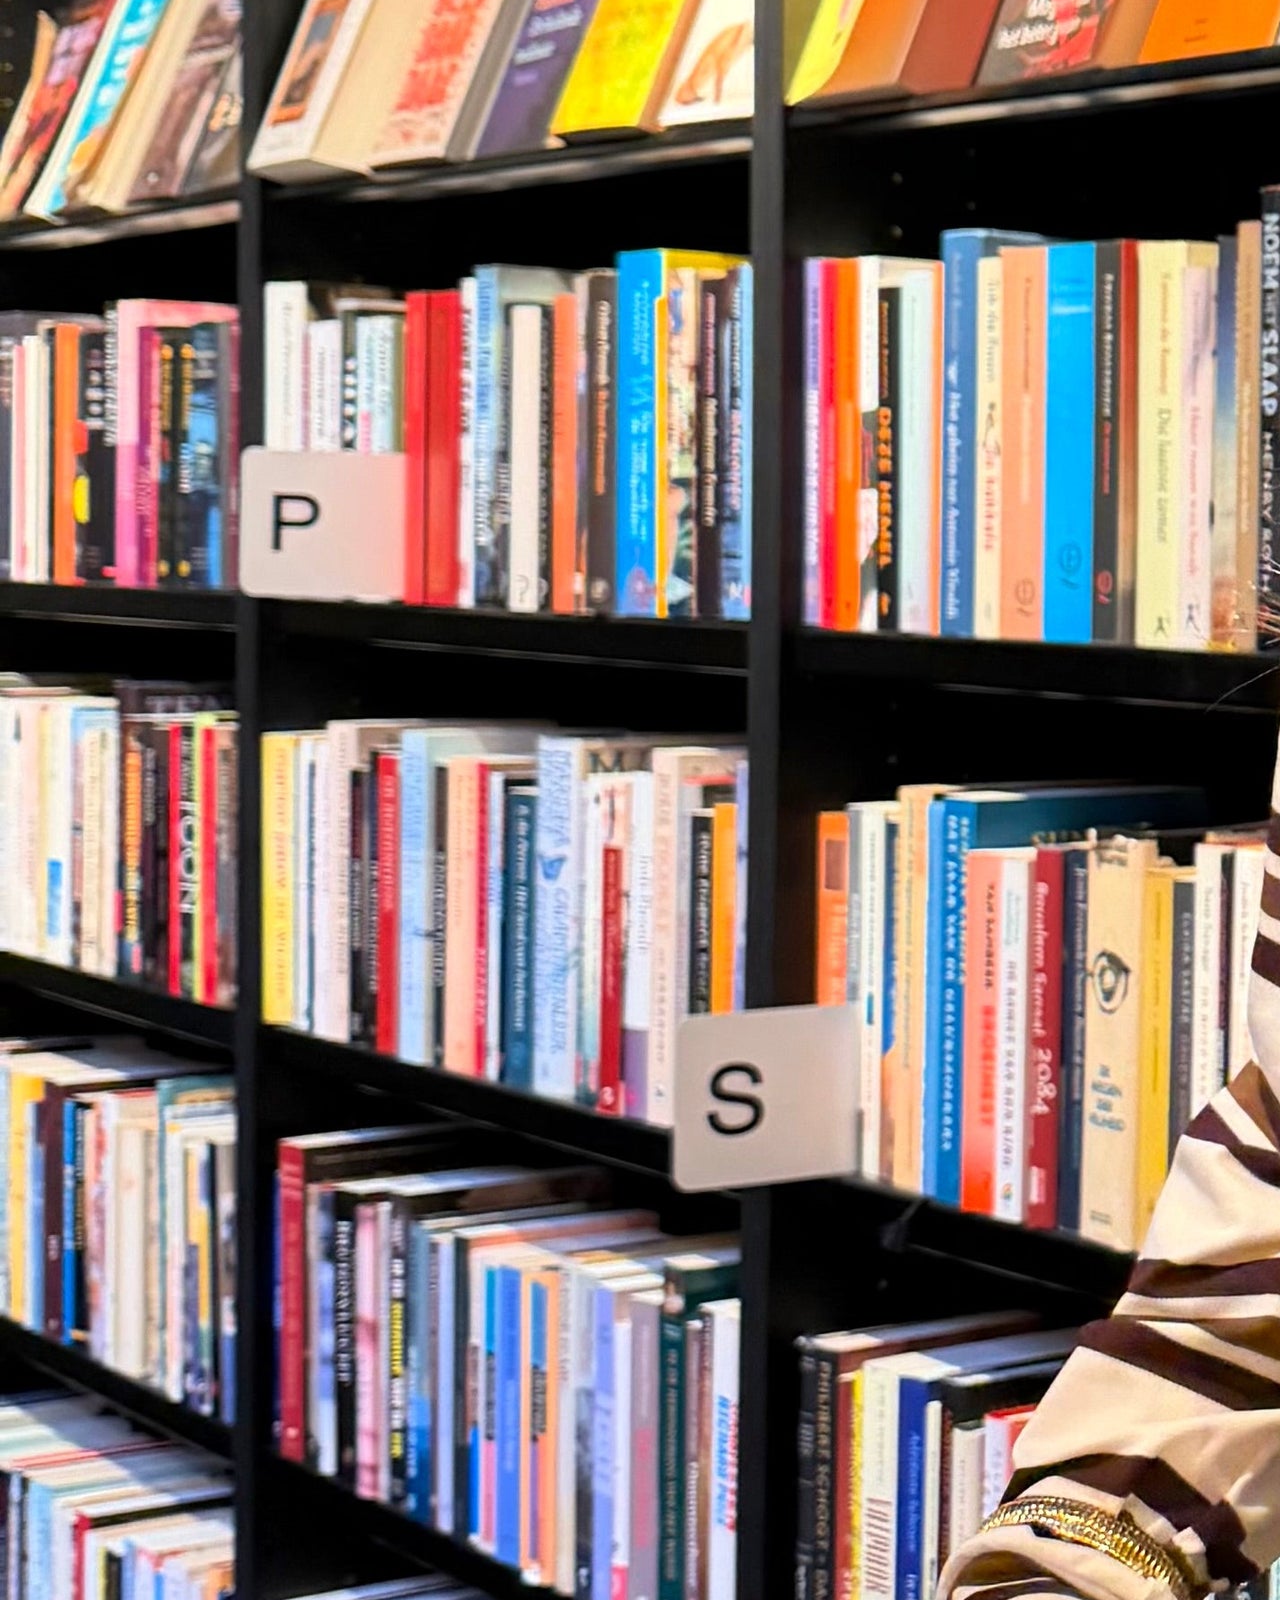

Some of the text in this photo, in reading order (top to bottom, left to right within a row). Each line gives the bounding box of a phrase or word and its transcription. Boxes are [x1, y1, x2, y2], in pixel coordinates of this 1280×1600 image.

[1260, 213, 1280, 416] NOEM SLAAP
[272, 492, 321, 552] P
[706, 1060, 766, 1137] S
